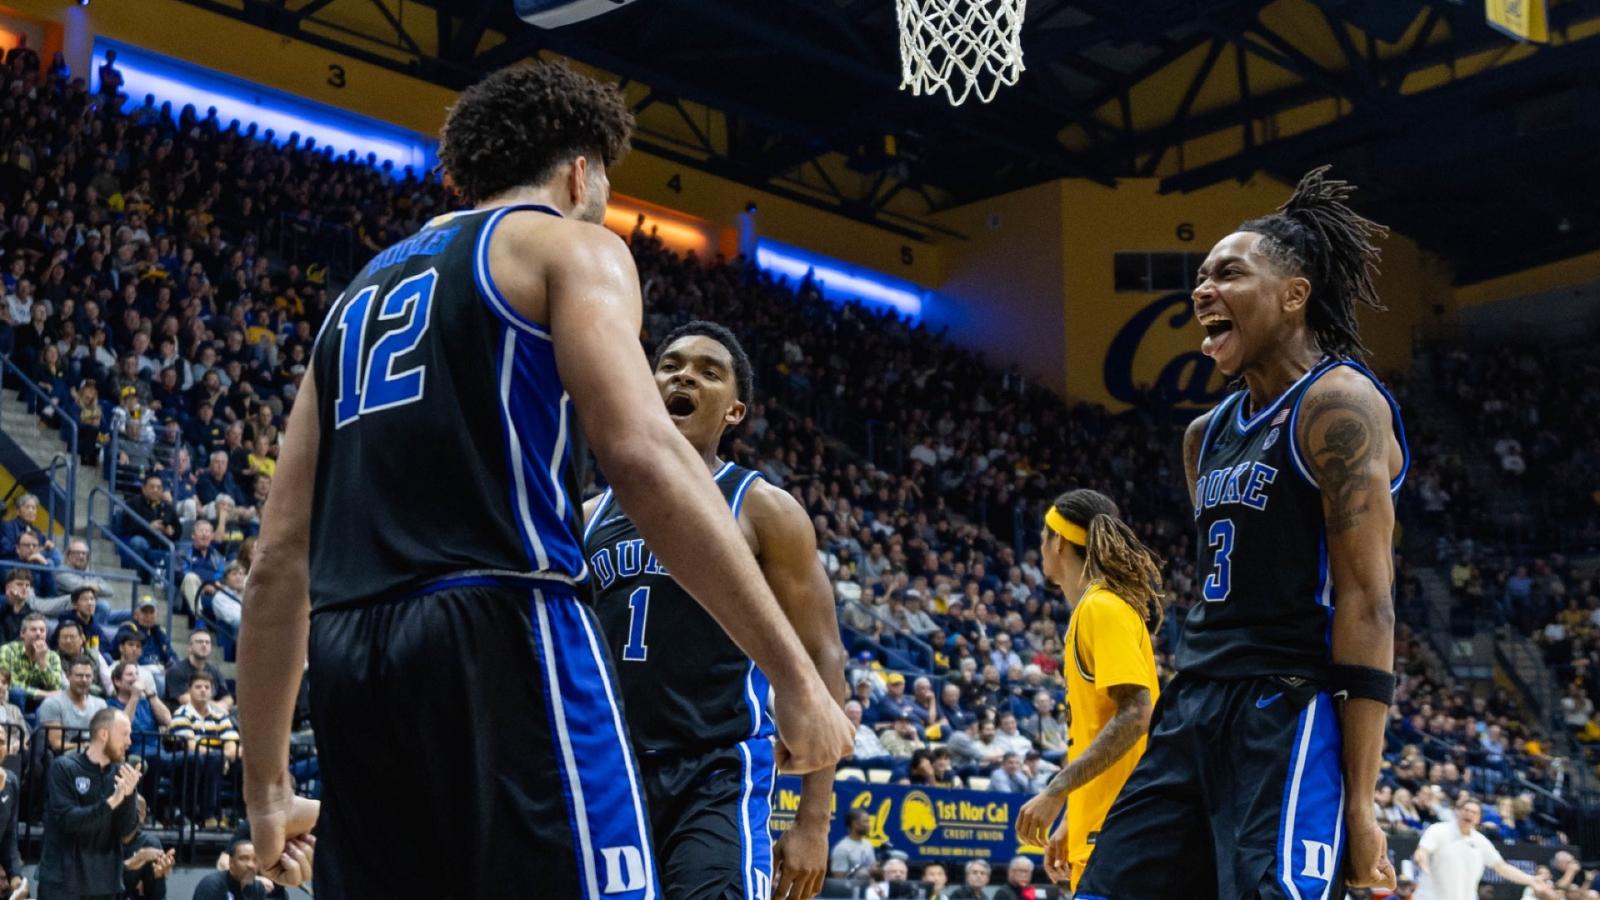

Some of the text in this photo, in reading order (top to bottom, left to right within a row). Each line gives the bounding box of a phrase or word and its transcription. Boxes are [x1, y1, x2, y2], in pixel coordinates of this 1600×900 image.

[327, 64, 346, 89] 3
[666, 174, 682, 194] 4
[1176, 223, 1195, 242] 6
[901, 245, 914, 266] 5
[334, 266, 439, 430] 12
[1104, 291, 1225, 404] Ca
[590, 538, 671, 590] DU
[1203, 518, 1235, 602] 3
[622, 586, 650, 661] 1
[780, 789, 802, 811] No
[936, 801, 1009, 823] 1st Nor Cal
[943, 828, 1004, 841] CREDIT UNION
[600, 845, 646, 894] D
